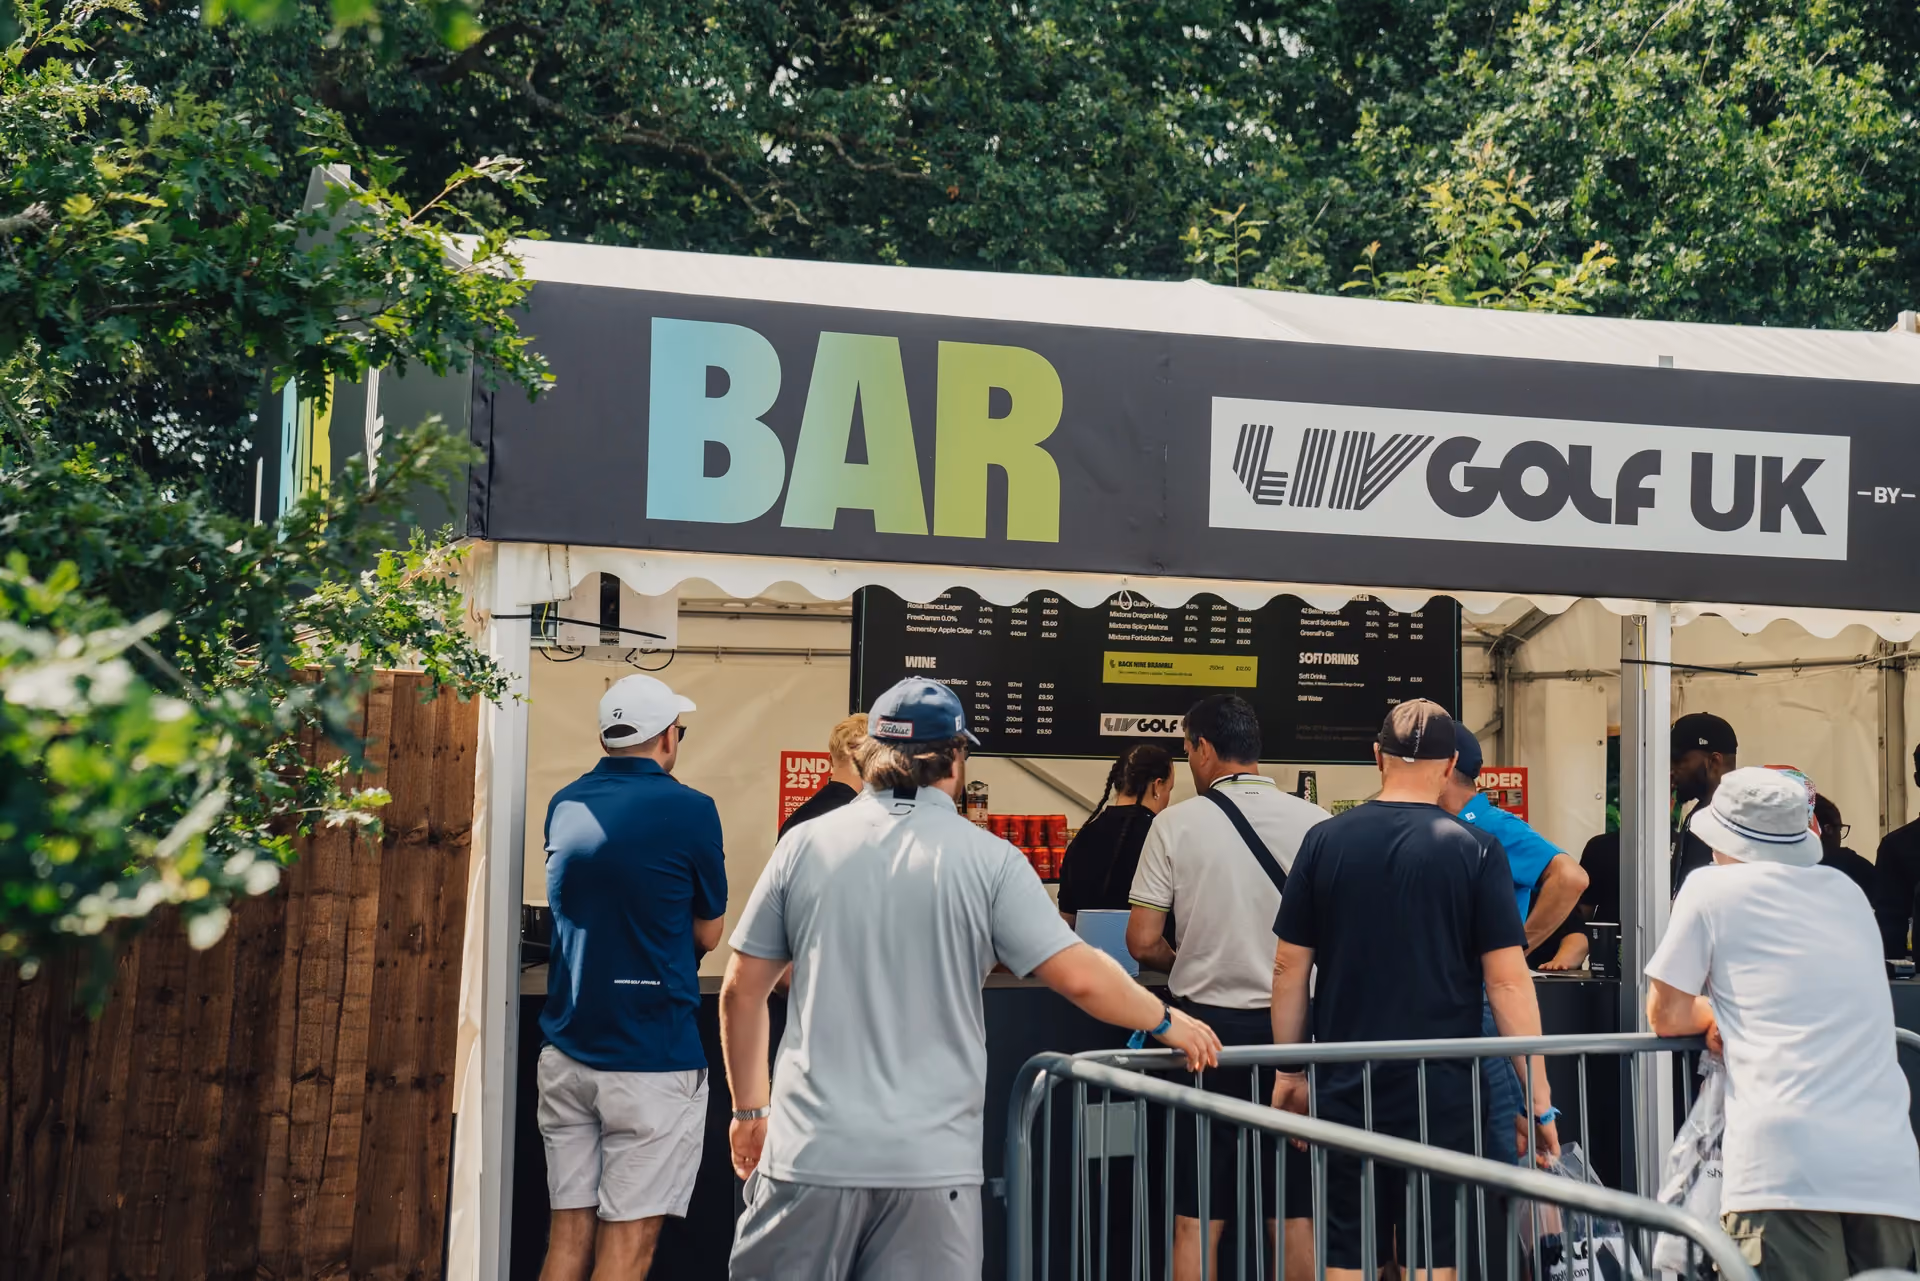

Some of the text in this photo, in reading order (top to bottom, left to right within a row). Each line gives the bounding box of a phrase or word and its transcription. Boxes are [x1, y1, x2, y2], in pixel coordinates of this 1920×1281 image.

[646, 317, 1064, 543] BAR
[1232, 423, 1435, 512] LIV
[1426, 435, 1661, 526] GOLF
[1689, 452, 1826, 537] UK
[944, 604, 963, 612] Lager
[906, 625, 938, 634] Somersby
[937, 627, 957, 635] Apple
[956, 627, 974, 635] Cider
[1130, 634, 1160, 642] Forbidden
[904, 655, 937, 669] WINE
[1118, 660, 1133, 668] BACK
[1298, 652, 1360, 666] SOFT DRINKS
[951, 678, 968, 686] Blanc
[878, 722, 910, 735] Titleist
[1137, 718, 1178, 733] GOLF
[786, 757, 833, 773] UND
[785, 773, 821, 789] 25?
[1474, 772, 1523, 787] NDER
